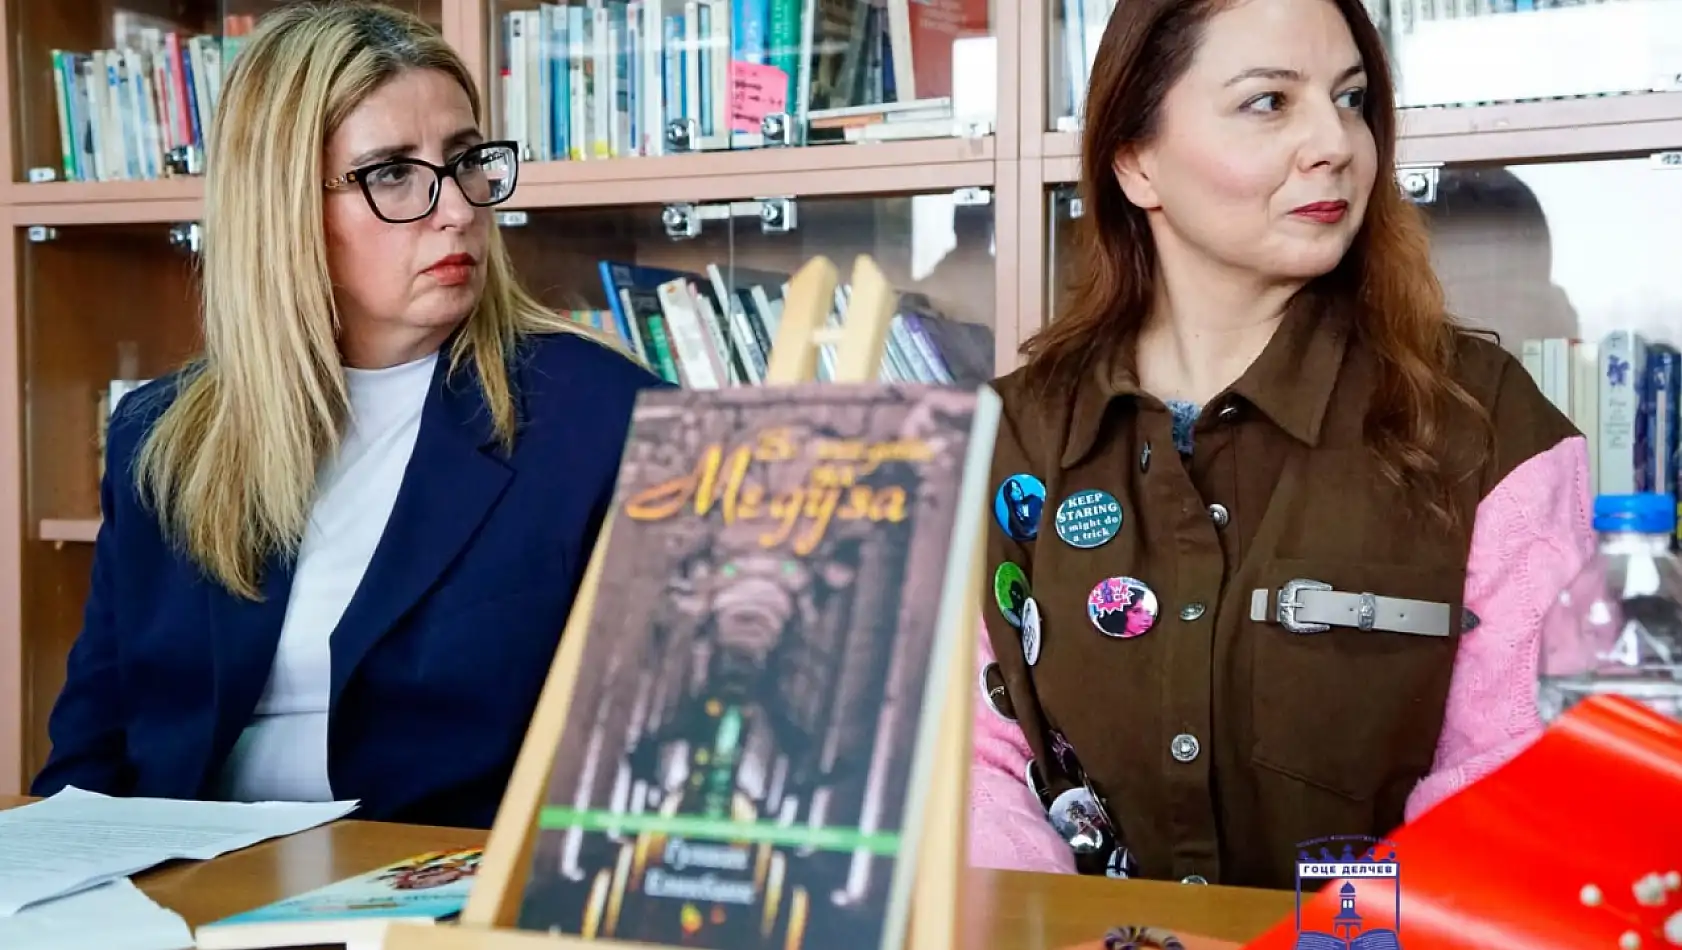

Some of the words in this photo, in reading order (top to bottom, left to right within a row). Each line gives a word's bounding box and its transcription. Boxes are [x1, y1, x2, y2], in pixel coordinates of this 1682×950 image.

[625, 444, 907, 555] Медуза
[1068, 492, 1103, 508] KEEP
[1057, 502, 1118, 522] STARING
[1060, 525, 1066, 534] I
[1069, 519, 1101, 533] might
[1104, 515, 1119, 525] do
[1073, 534, 1080, 542] a
[1082, 527, 1110, 539] trick
